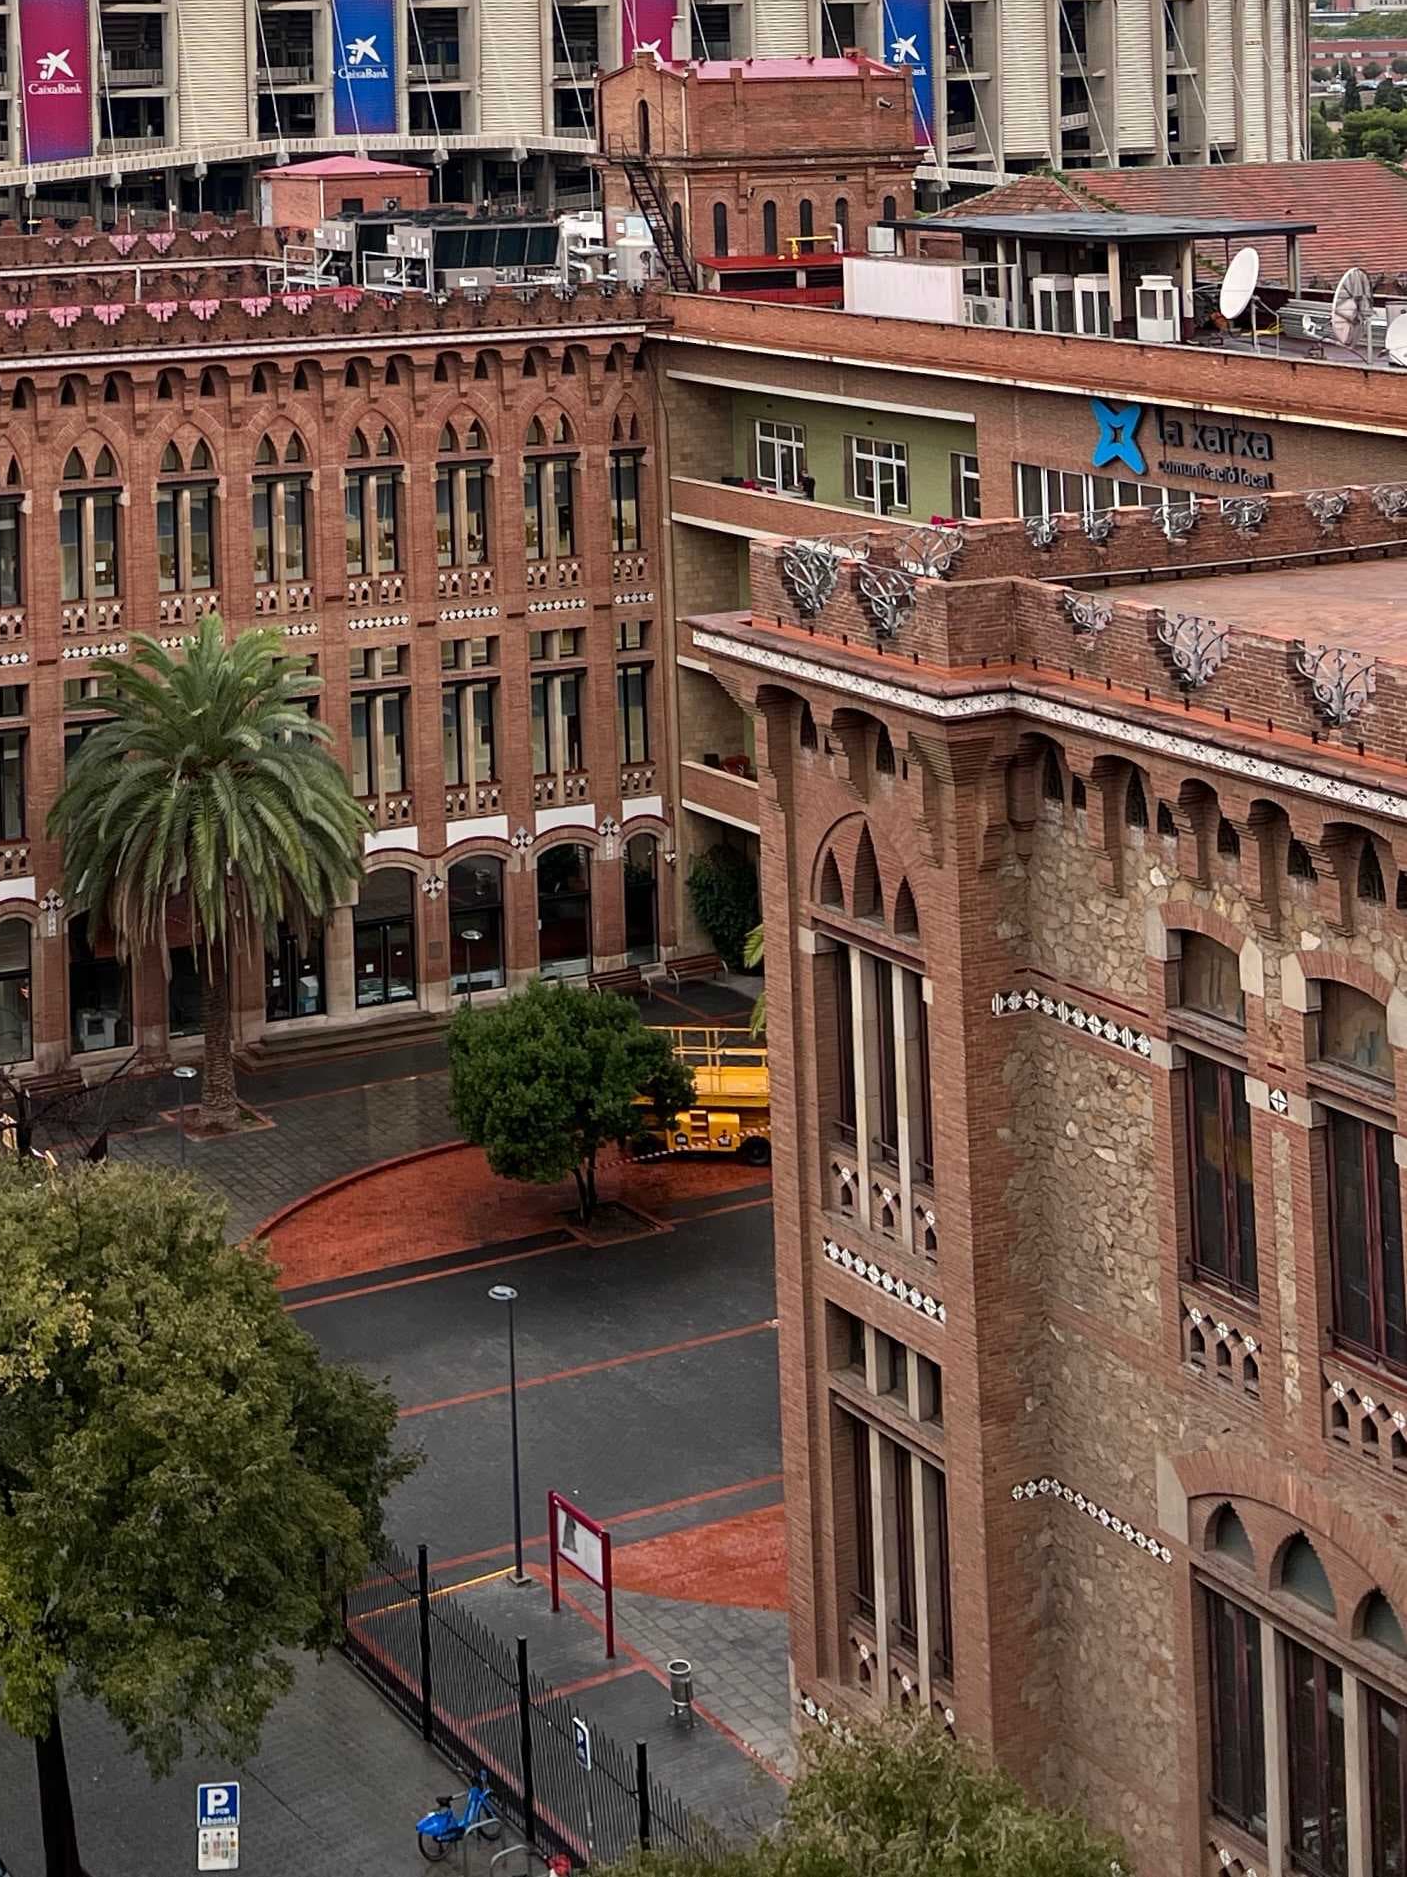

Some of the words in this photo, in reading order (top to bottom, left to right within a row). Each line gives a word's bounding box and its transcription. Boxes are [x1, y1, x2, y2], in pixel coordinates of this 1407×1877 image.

[337, 67, 389, 79] CaixaBank
[28, 83, 82, 95] CaixaBank
[1155, 408, 1184, 447] la
[1192, 425, 1274, 461] xarxa
[1239, 467, 1275, 490] local
[207, 1788, 229, 1815] P
